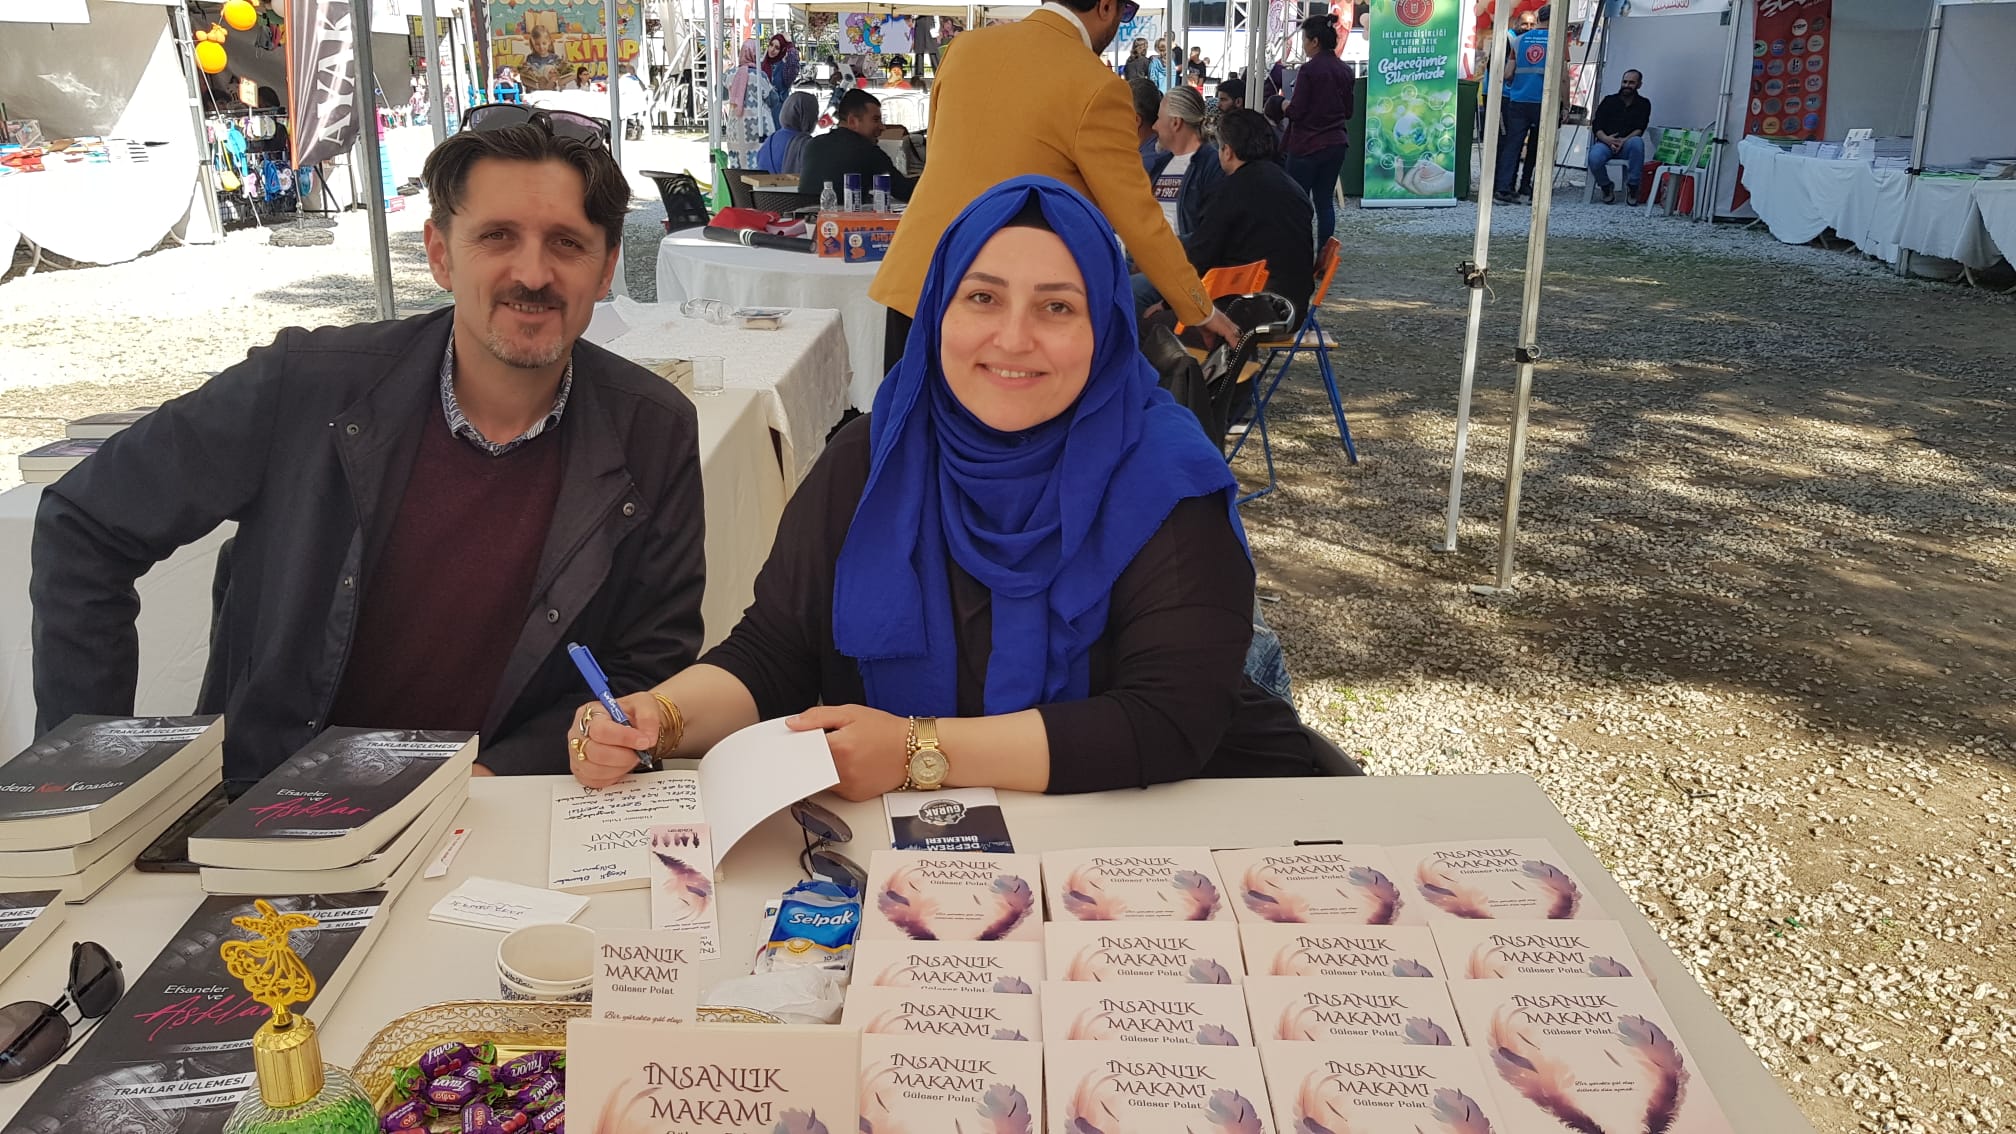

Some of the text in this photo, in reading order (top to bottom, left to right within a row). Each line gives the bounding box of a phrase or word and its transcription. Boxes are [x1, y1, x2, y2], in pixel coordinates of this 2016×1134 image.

[565, 34, 640, 62] KİTP
[1377, 55, 1448, 74] Geleceğimiz
[317, 10, 355, 146] AYAK
[1385, 66, 1445, 85] Ellerimizde
[590, 828, 651, 842] AKAMI
[927, 843, 981, 851] DEPREM
[1273, 864, 1346, 874] MAKAMI
[1445, 858, 1519, 869] MAKAMI
[921, 869, 993, 880] MAKAMI
[1100, 866, 1172, 876] MAKAMI
[0, 908, 36, 918] EMESİ
[789, 910, 854, 927] Selpak
[1104, 953, 1188, 967] MAKAMI
[1305, 952, 1389, 966] MAKAMI
[1500, 950, 1585, 964] MAKAMI
[604, 964, 678, 982] MAKAMI
[911, 970, 993, 984] MAKAMI
[164, 985, 229, 994] Efsaneler
[650, 986, 674, 995] Polat
[1107, 1016, 1193, 1032] MAKAMI
[1312, 1010, 1401, 1026] MAKAMI
[1521, 1011, 1613, 1026] MAKAMI
[904, 1018, 990, 1036] MAKAMI
[1372, 1028, 1400, 1037] Polat
[1585, 1028, 1613, 1036] Polat
[1162, 1036, 1189, 1044] Polat
[113, 1075, 247, 1096] TRAKLAR ÜÇLEMESİ
[893, 1071, 984, 1092] MAKAMI
[1112, 1078, 1206, 1098] MAKAMI
[1336, 1078, 1429, 1097] MAKAMI
[205, 1095, 235, 1104] KİTAP
[947, 1094, 976, 1103] Polat
[1173, 1100, 1201, 1109] Polat
[1398, 1099, 1426, 1108] Polat
[537, 1101, 565, 1124] Favor
[649, 1096, 773, 1126] MAKAMI
